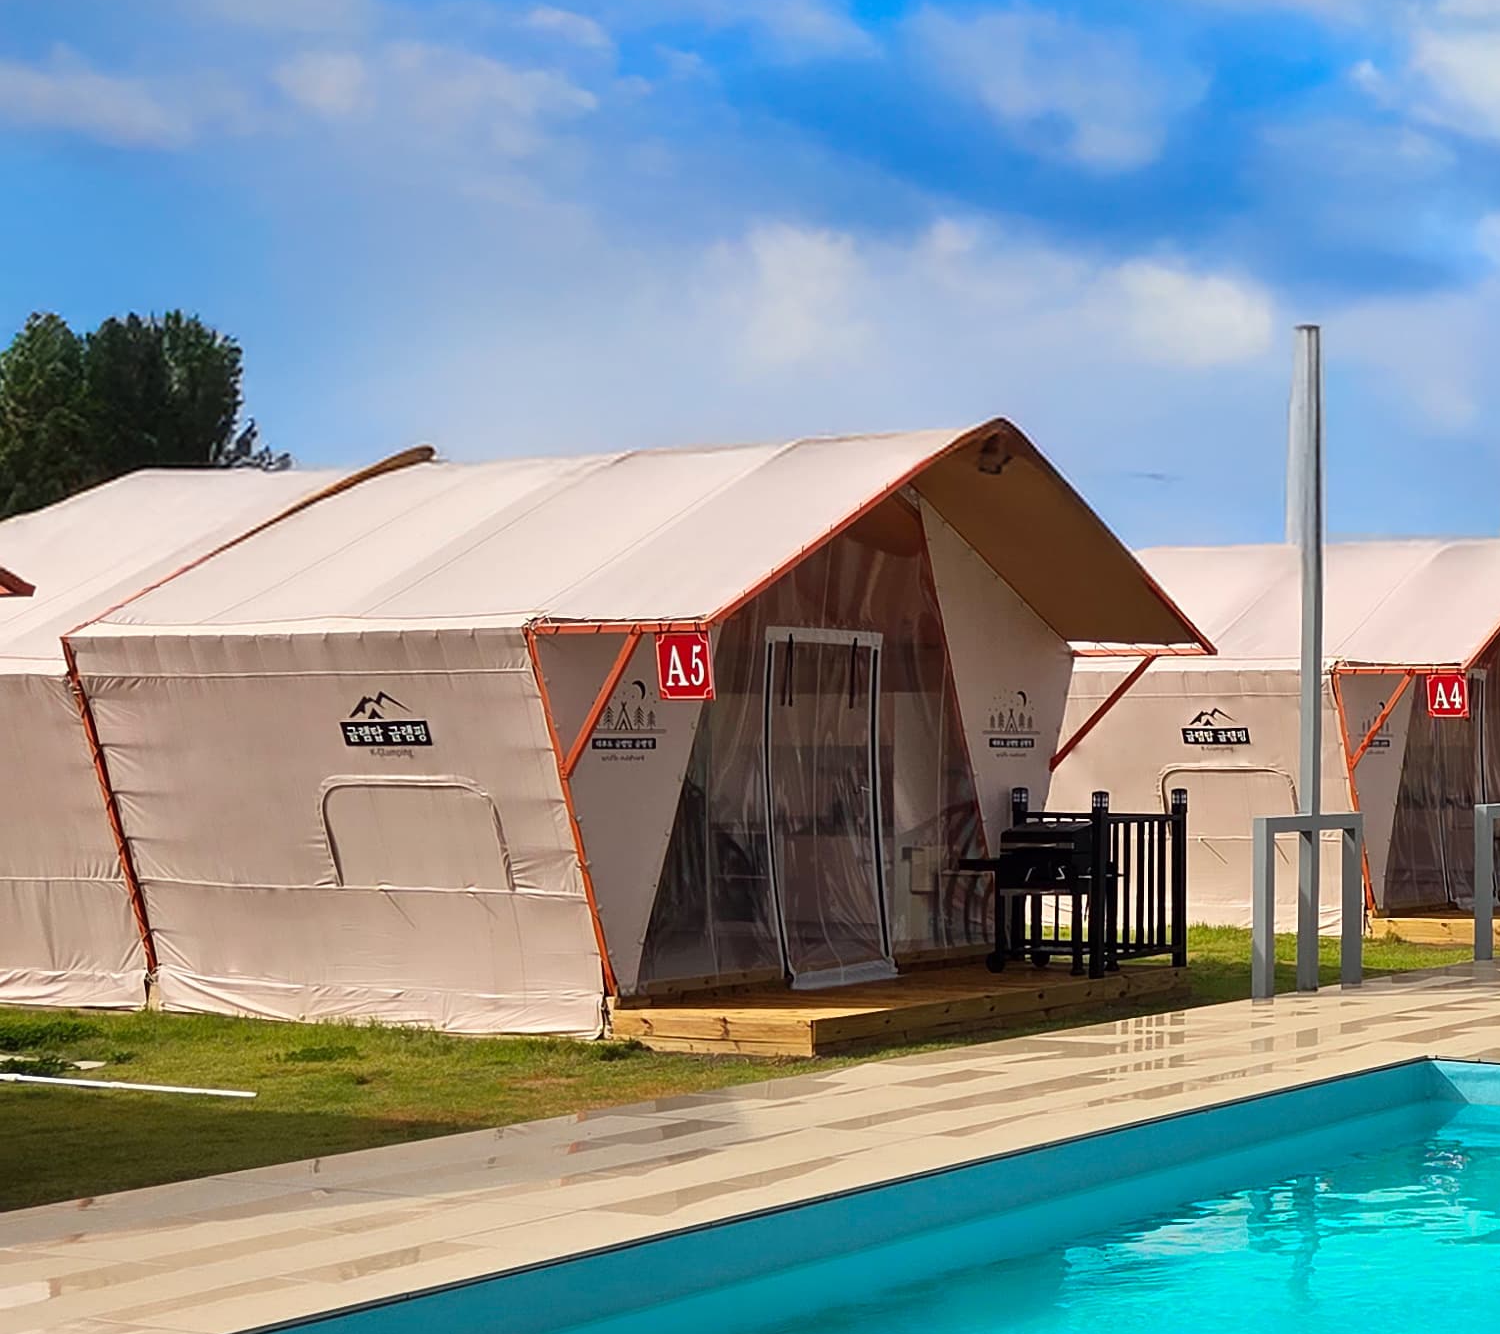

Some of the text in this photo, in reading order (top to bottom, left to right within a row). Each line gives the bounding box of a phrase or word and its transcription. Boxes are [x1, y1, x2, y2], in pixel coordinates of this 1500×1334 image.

[666, 644, 705, 686] A5
[1433, 682, 1463, 709] A4
[346, 724, 427, 743] 글램탑 글램핑
